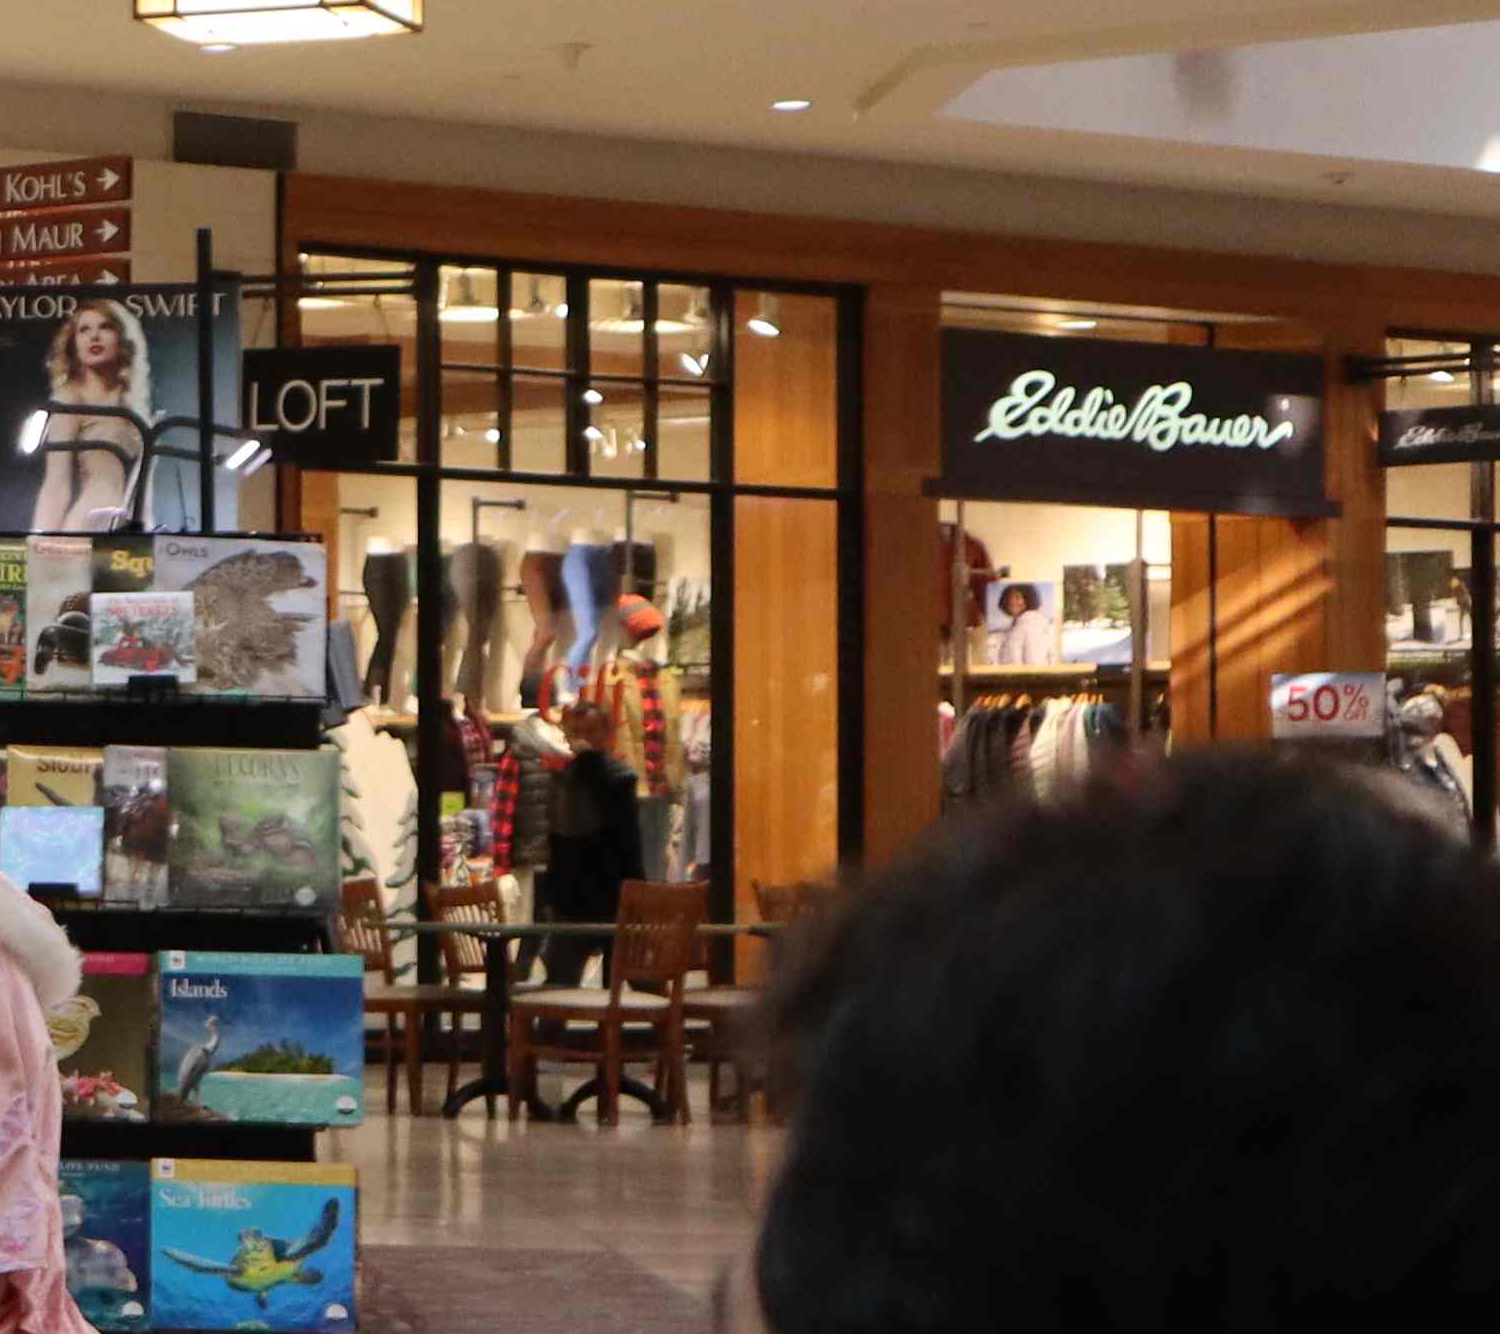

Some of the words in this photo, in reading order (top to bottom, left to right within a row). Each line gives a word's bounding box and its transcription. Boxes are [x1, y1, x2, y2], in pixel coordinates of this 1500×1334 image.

[4, 170, 87, 203] KOHL'S
[10, 222, 85, 253] MAUR
[123, 292, 228, 318] SWIFT
[251, 377, 386, 432] LOFT
[972, 369, 1127, 443] Eddie
[1128, 381, 1294, 451] Bauer
[170, 978, 228, 999] Islands
